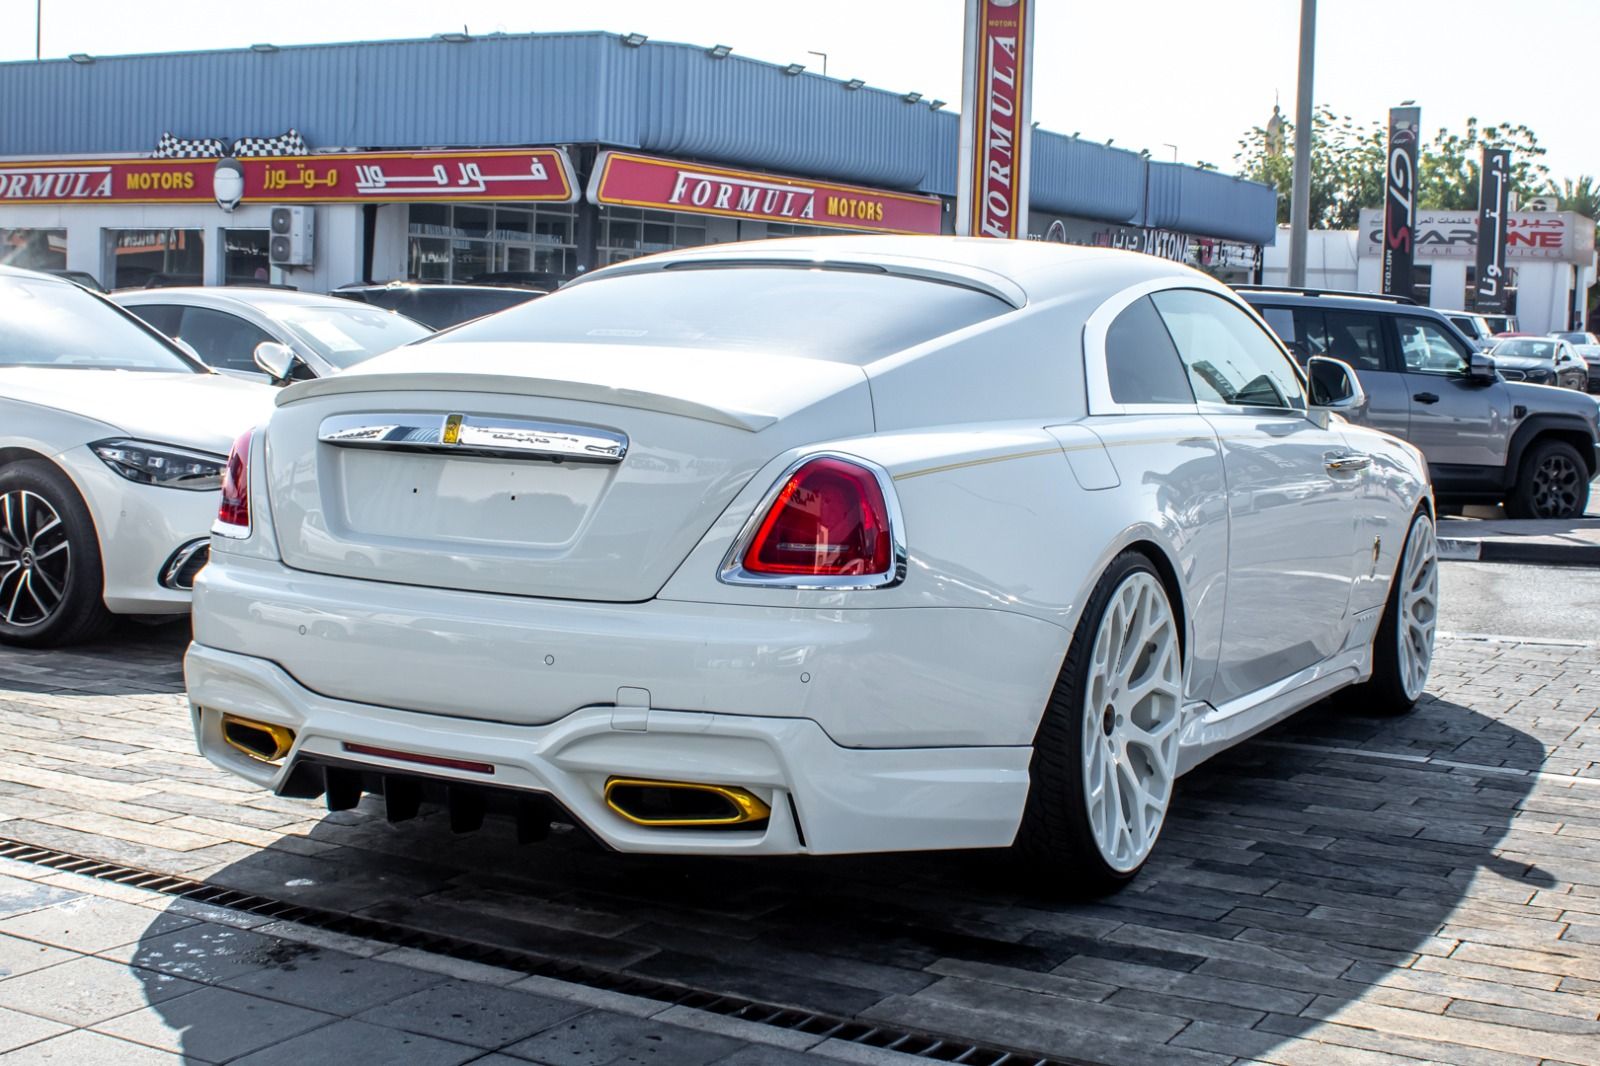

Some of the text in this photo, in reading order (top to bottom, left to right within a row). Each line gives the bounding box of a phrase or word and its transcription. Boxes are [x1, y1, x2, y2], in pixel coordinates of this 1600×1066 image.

[981, 35, 1016, 238] FORMULA
[127, 172, 194, 190] MOTORS
[263, 164, 338, 189] موتورز
[668, 171, 884, 221] FORMULA MOTORS
